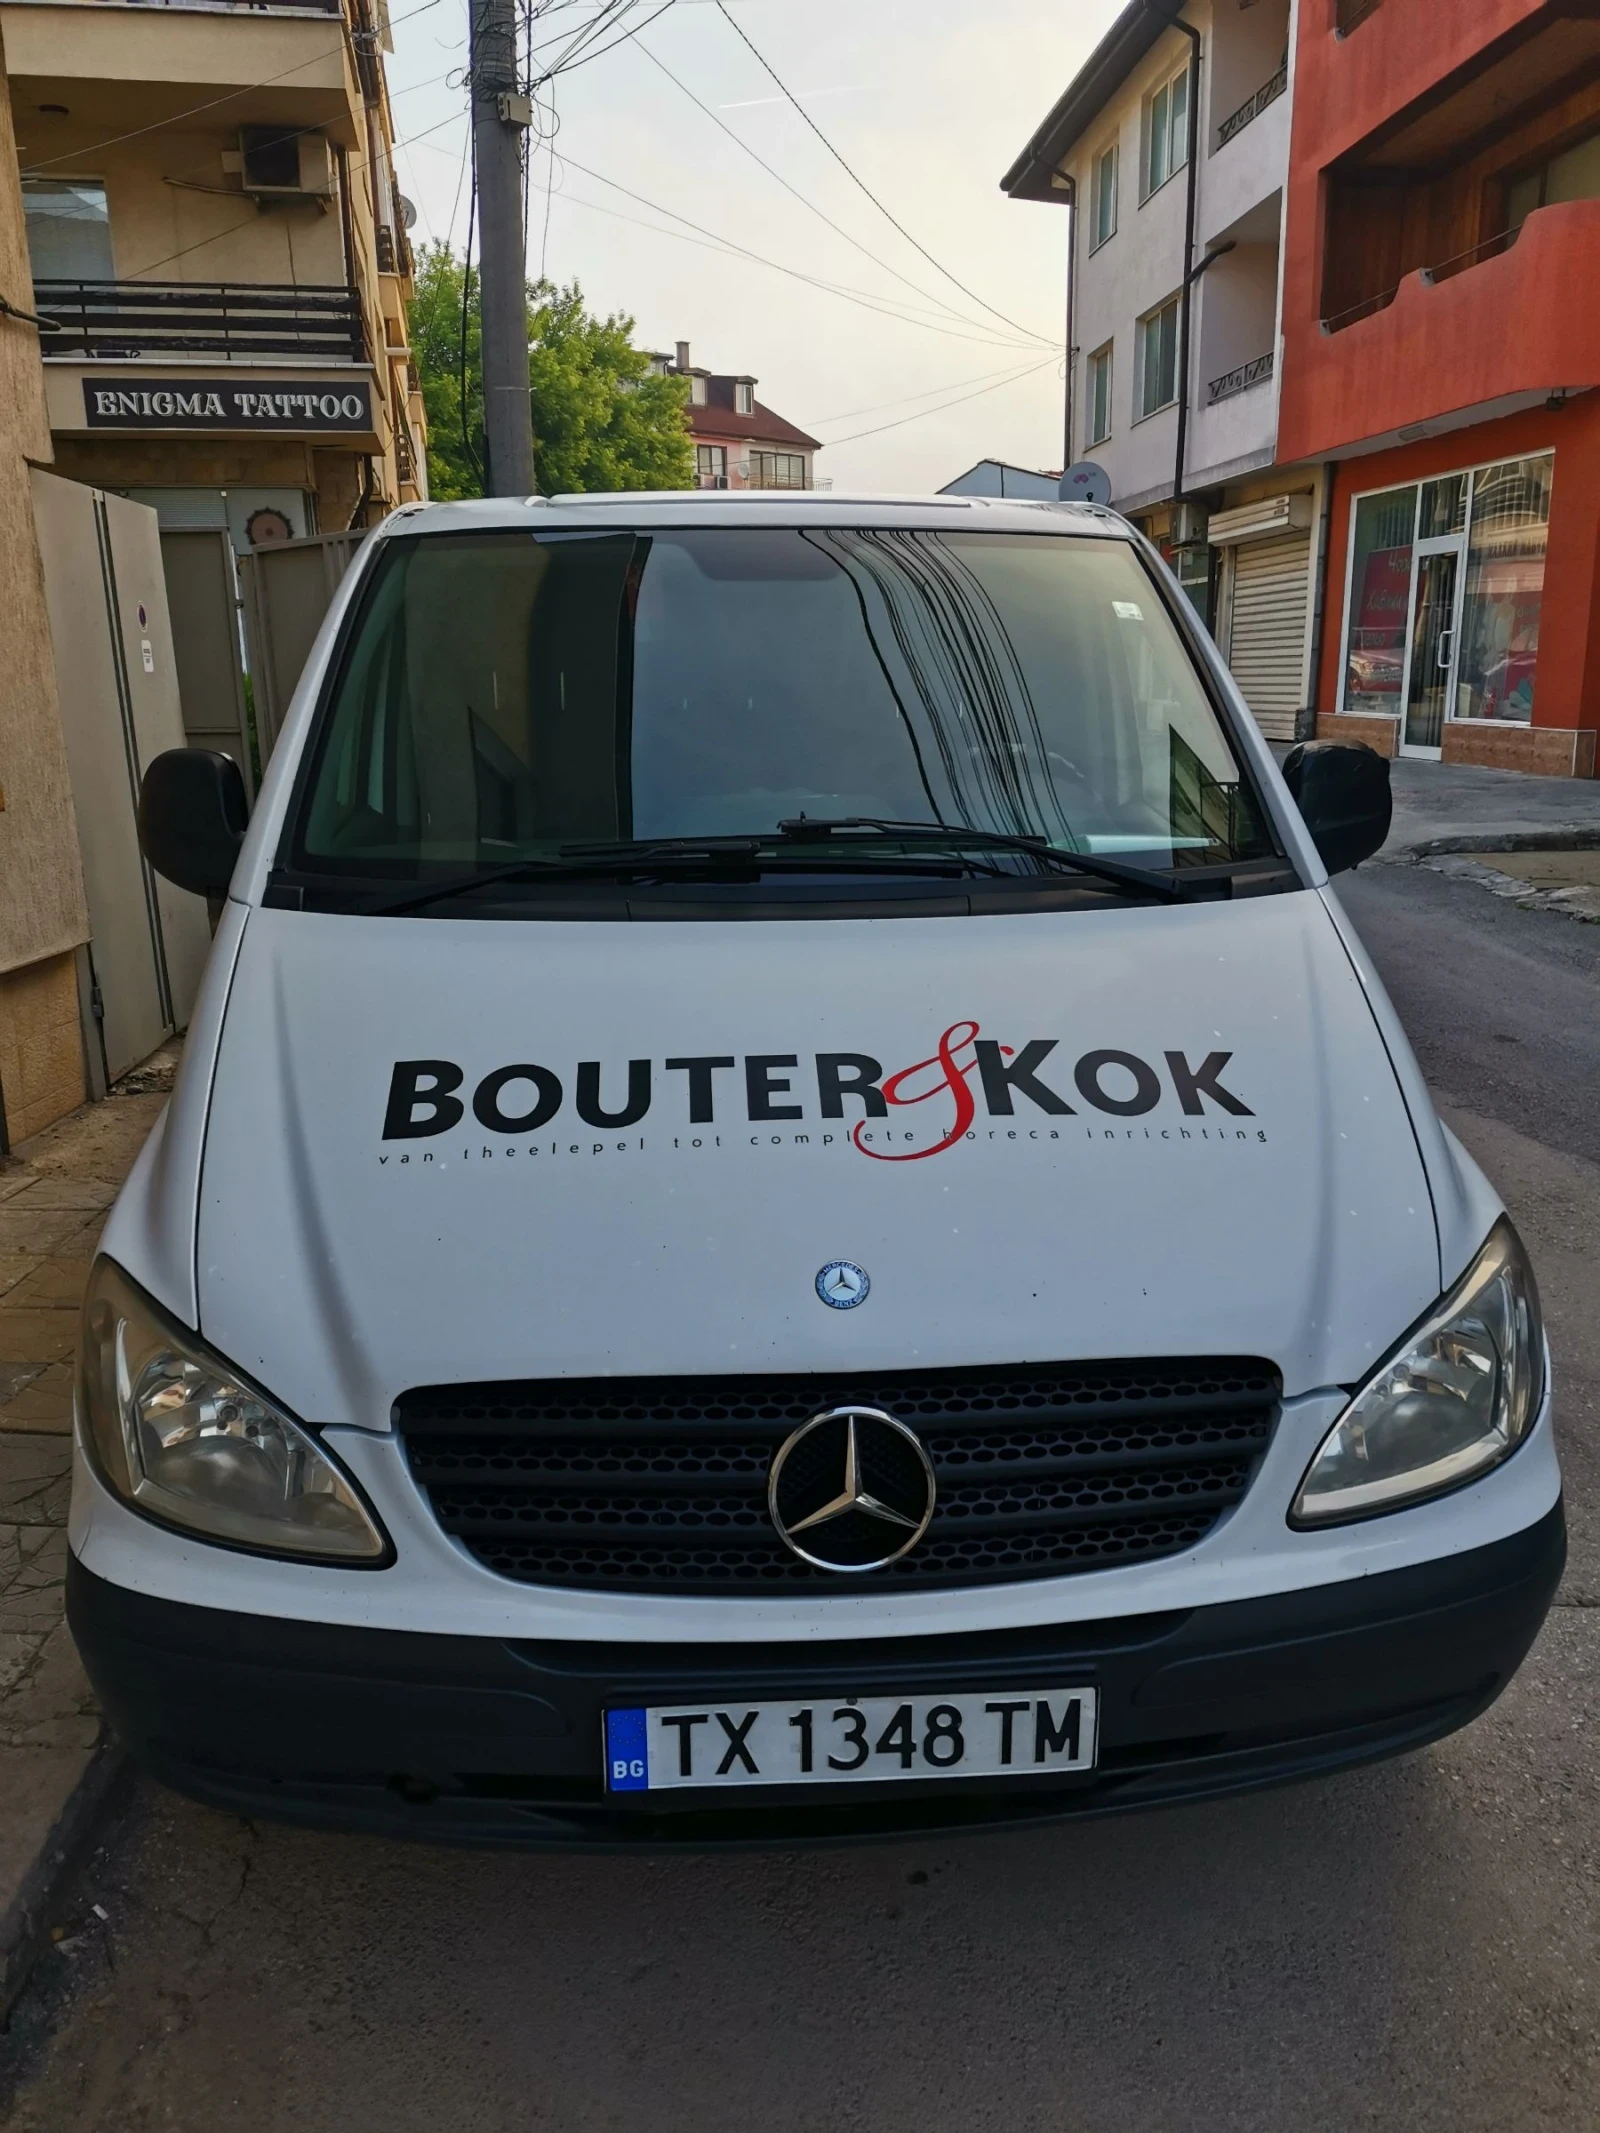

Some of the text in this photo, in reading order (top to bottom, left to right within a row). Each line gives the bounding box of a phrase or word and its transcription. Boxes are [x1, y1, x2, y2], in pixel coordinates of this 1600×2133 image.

[93, 391, 365, 420] ENIGMA TATTOO
[381, 1052, 889, 1141] BOUTER
[973, 1039, 1257, 1117] KOK
[378, 1126, 1268, 1165] van theelepel tot complete horeca inrichting
[661, 1698, 1081, 1777] TX 1348 TM
[613, 1759, 645, 1779] BG
